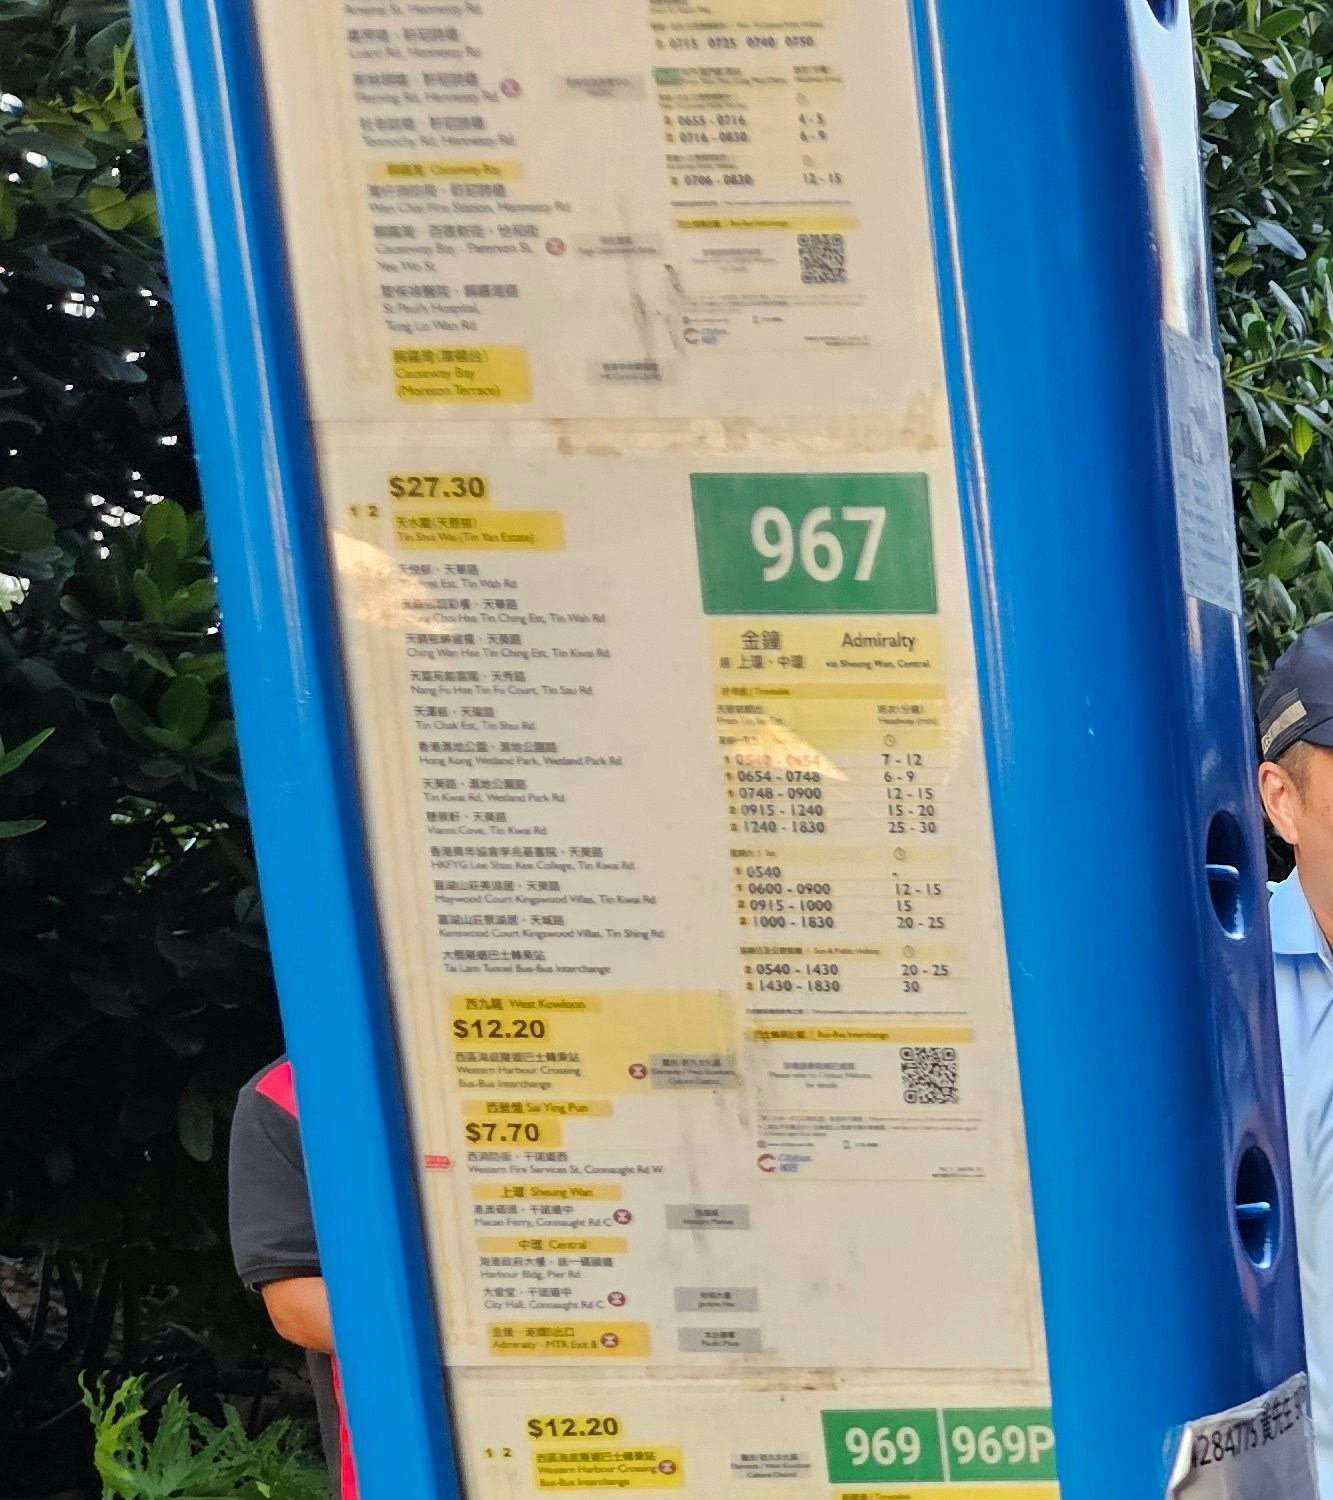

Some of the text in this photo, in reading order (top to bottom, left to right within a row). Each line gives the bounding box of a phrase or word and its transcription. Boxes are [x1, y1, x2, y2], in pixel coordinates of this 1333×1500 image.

[389, 476, 485, 500] $27.30
[751, 506, 886, 582] 967
[841, 632, 916, 652] Admiralty
[738, 771, 820, 782] 0654 0748
[739, 788, 821, 799] 0748 0900
[741, 805, 823, 816] 0915 1240
[744, 822, 825, 833] 1240 1830
[747, 866, 781, 878] 0540
[748, 883, 831, 895] 0600 0900
[750, 900, 832, 911] 0915 1000
[754, 917, 833, 928] 1000 1830
[756, 964, 838, 975] 0540 1430
[760, 981, 840, 992] 1430 1830
[510, 1000, 536, 1008] West
[538, 999, 585, 1009] Kowloon
[454, 1019, 545, 1039] $12.20
[543, 1102, 566, 1114] Ying
[568, 1102, 588, 1112] Pun
[466, 1122, 540, 1142] $7.70
[531, 1187, 567, 1199] Sheung
[570, 1187, 592, 1197] Wan
[549, 1240, 587, 1250] Central
[528, 1417, 618, 1438] $12.20
[846, 1425, 1054, 1466] 969 969P
